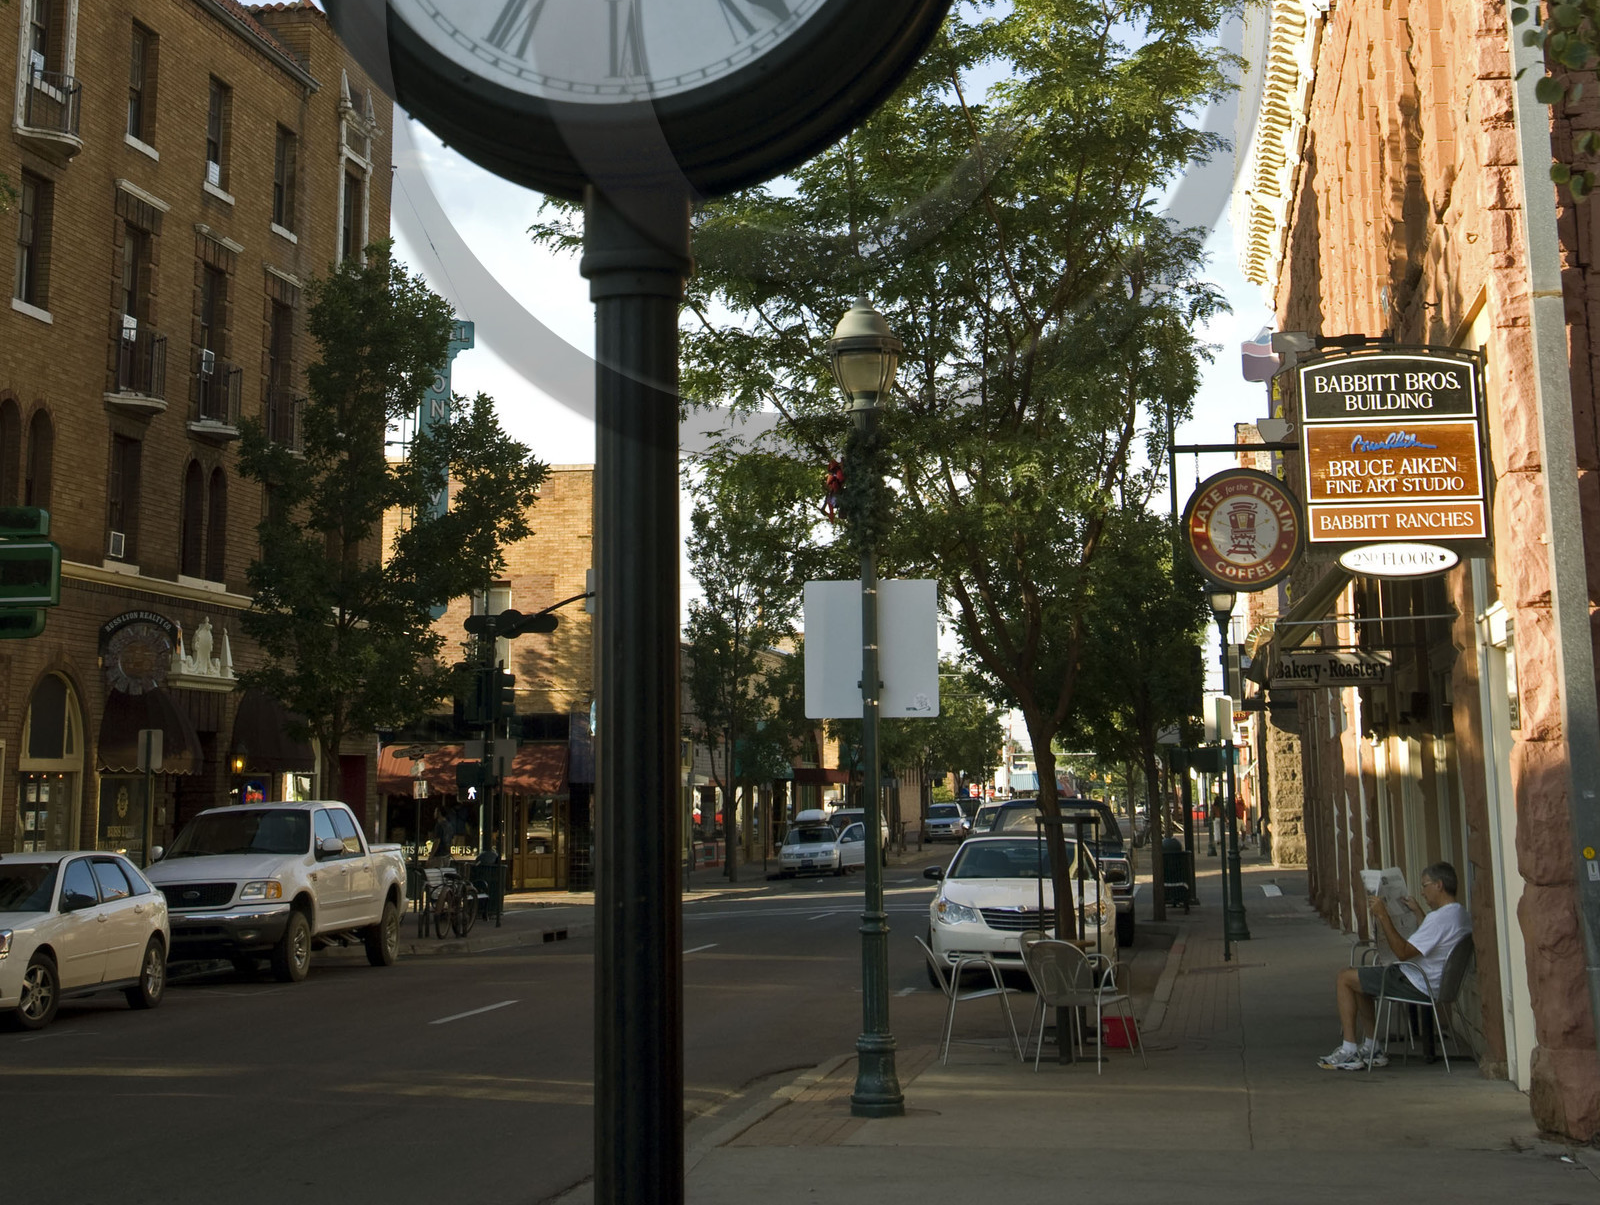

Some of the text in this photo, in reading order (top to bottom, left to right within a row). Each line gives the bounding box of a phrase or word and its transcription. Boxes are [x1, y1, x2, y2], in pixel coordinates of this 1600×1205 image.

[1314, 372, 1461, 394] BABBITT BROS.
[1345, 393, 1433, 411] BUILDING
[1328, 457, 1457, 477] BRUCE AIKEN
[1326, 477, 1465, 494] FINE ART STUDIO
[1194, 489, 1223, 533] LATE
[1225, 485, 1236, 495] for
[1252, 482, 1294, 532] TRAIN
[1320, 511, 1474, 530] BABBITT RANCHES
[1383, 552, 1434, 565] FLOOR
[1215, 561, 1276, 579] COFFEE
[1276, 660, 1322, 683] Bakery
[1328, 660, 1387, 681] Roastery
[450, 846, 471, 855] GIFTS
